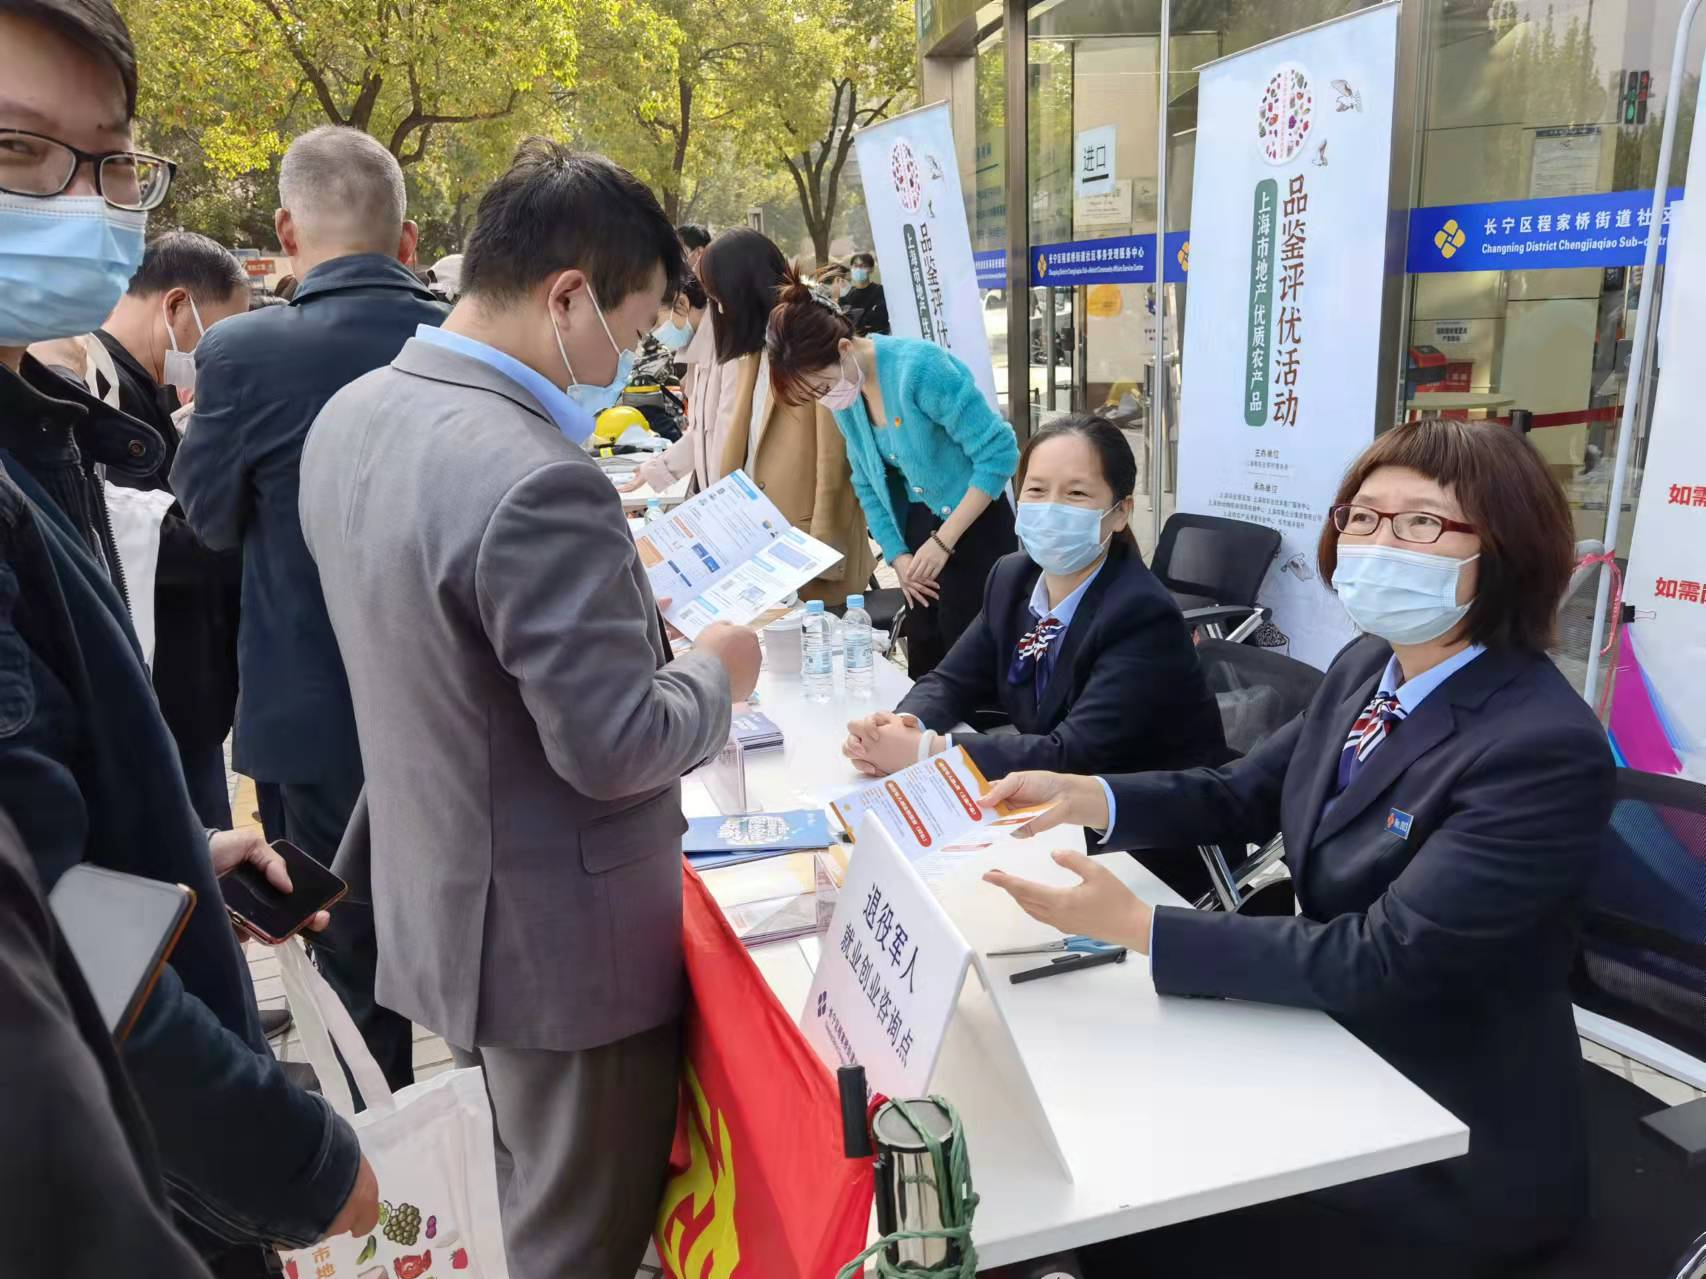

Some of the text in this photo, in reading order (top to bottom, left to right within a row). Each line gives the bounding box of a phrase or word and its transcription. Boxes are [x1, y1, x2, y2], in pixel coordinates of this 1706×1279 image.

[1083, 144, 1106, 172] 进口
[1273, 174, 1309, 427] 品鉴评优活动
[1482, 241, 1525, 255] Changning
[1526, 238, 1557, 252] District
[1558, 235, 1617, 251] Chengjiaqiao
[1249, 192, 1272, 411] 上海市地产优质农产品
[1655, 577, 1706, 604] 如需
[863, 882, 919, 994] 退役军人
[840, 922, 915, 1069] 就业创业咨询点
